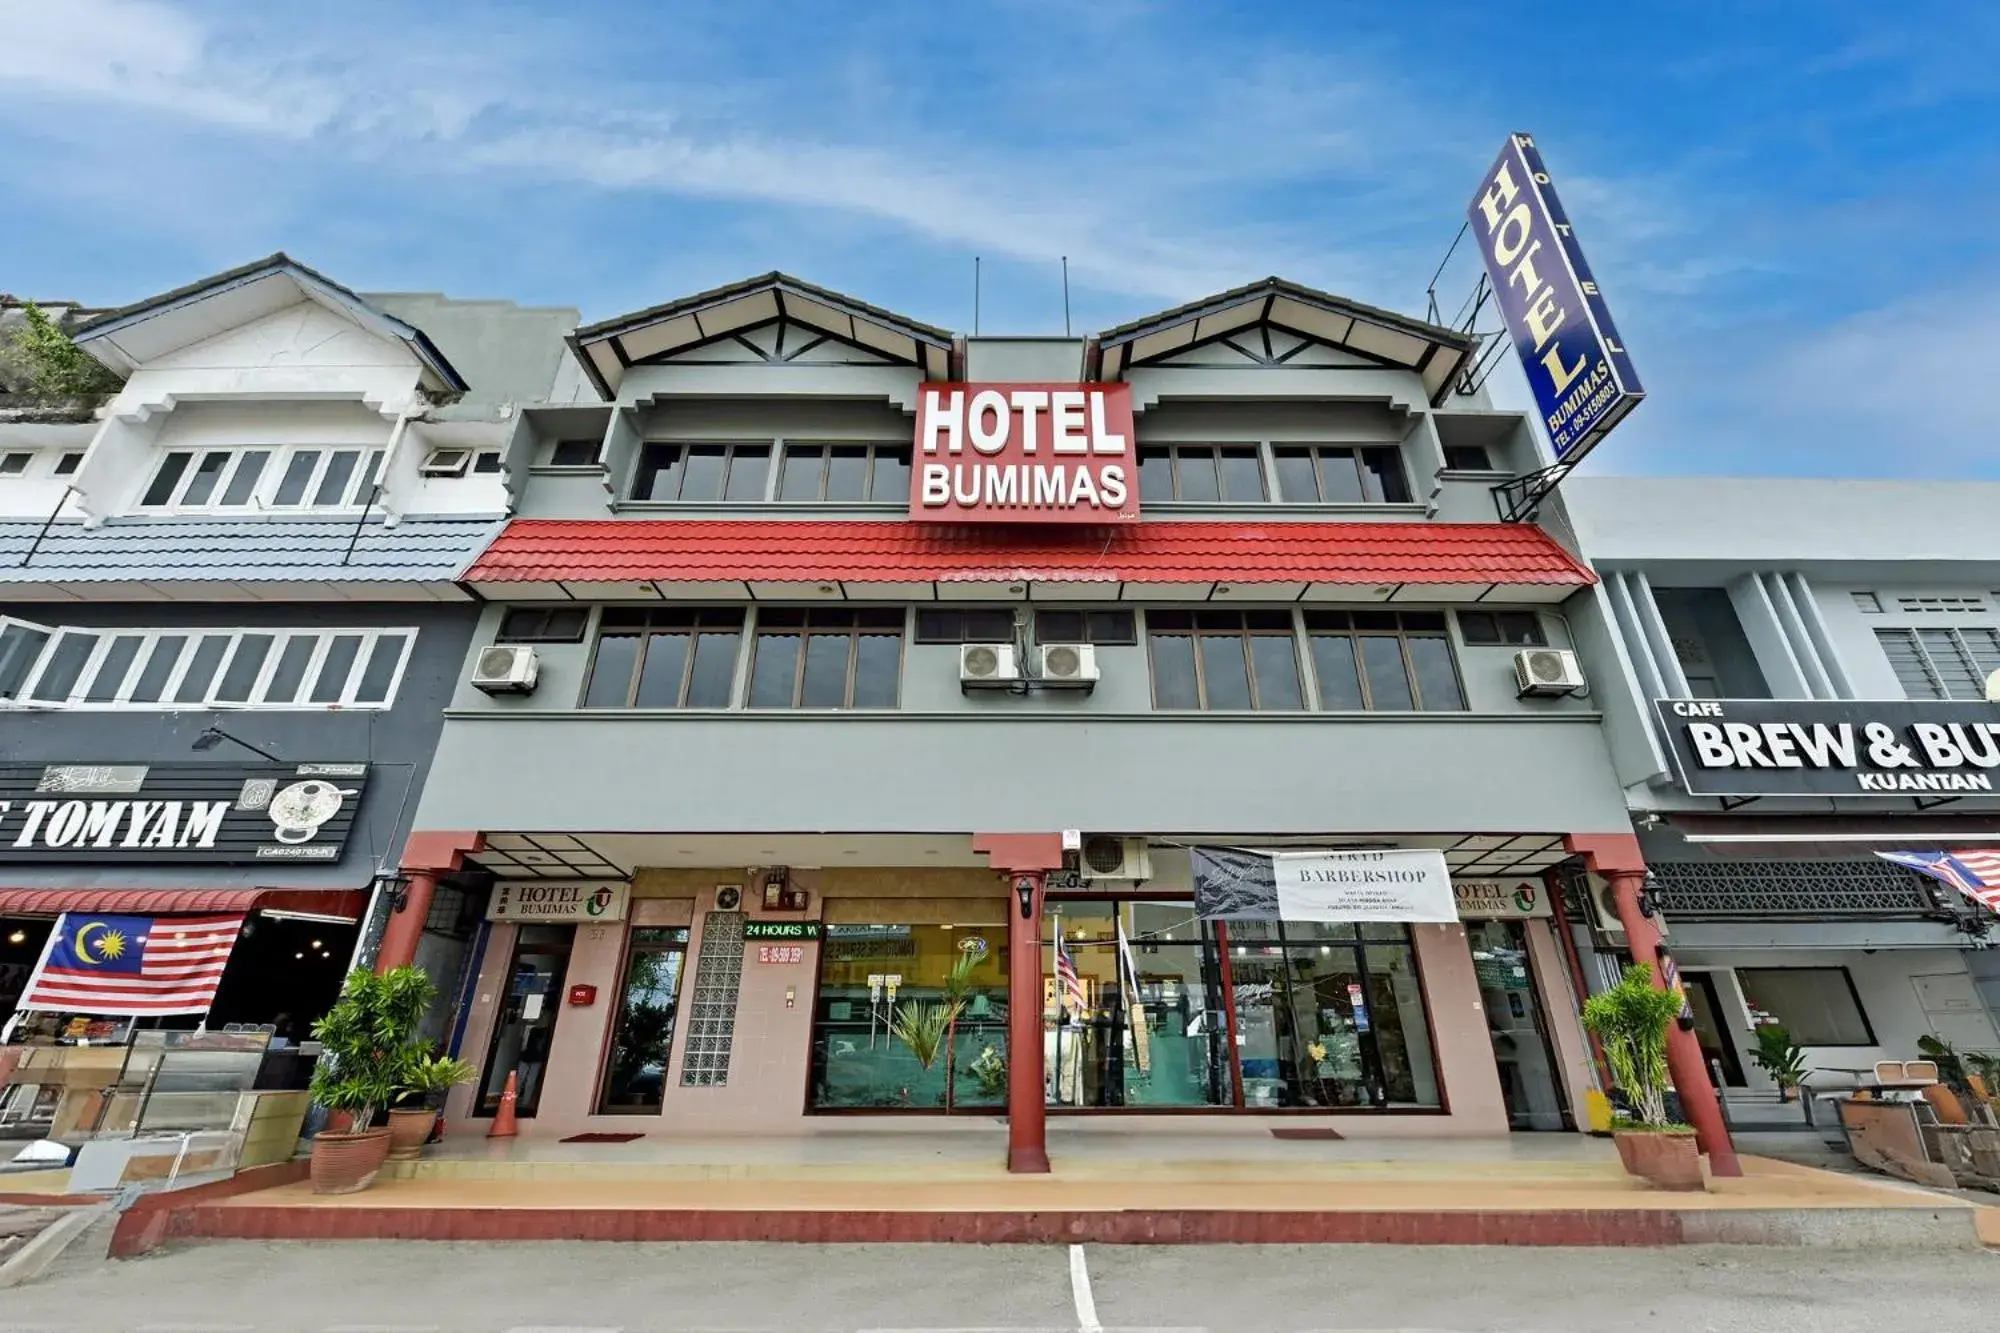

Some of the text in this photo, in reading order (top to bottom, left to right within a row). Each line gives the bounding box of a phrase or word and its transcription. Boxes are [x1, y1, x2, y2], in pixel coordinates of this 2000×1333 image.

[1518, 136, 1624, 354] HOTEL
[1478, 160, 1586, 398] HOTEL
[1547, 359, 1608, 433] BUMIMAS
[922, 390, 1126, 455] HOTEL
[922, 463, 1128, 508] BUMIMAS
[1673, 702, 1724, 717] CAFE
[1688, 722, 1858, 768] BREW
[1863, 721, 1921, 768] &
[1856, 773, 1993, 790] KUANTAN
[12, 800, 231, 848] TOMYAM
[1300, 870, 1427, 883] BARBERSHOP
[519, 887, 584, 903] HOTEL
[1453, 883, 1508, 898] OTEL
[520, 904, 578, 914] BUMIMAS
[1459, 900, 1508, 910] UMIMAS
[746, 925, 760, 935] 24
[762, 925, 802, 935] HOURS
